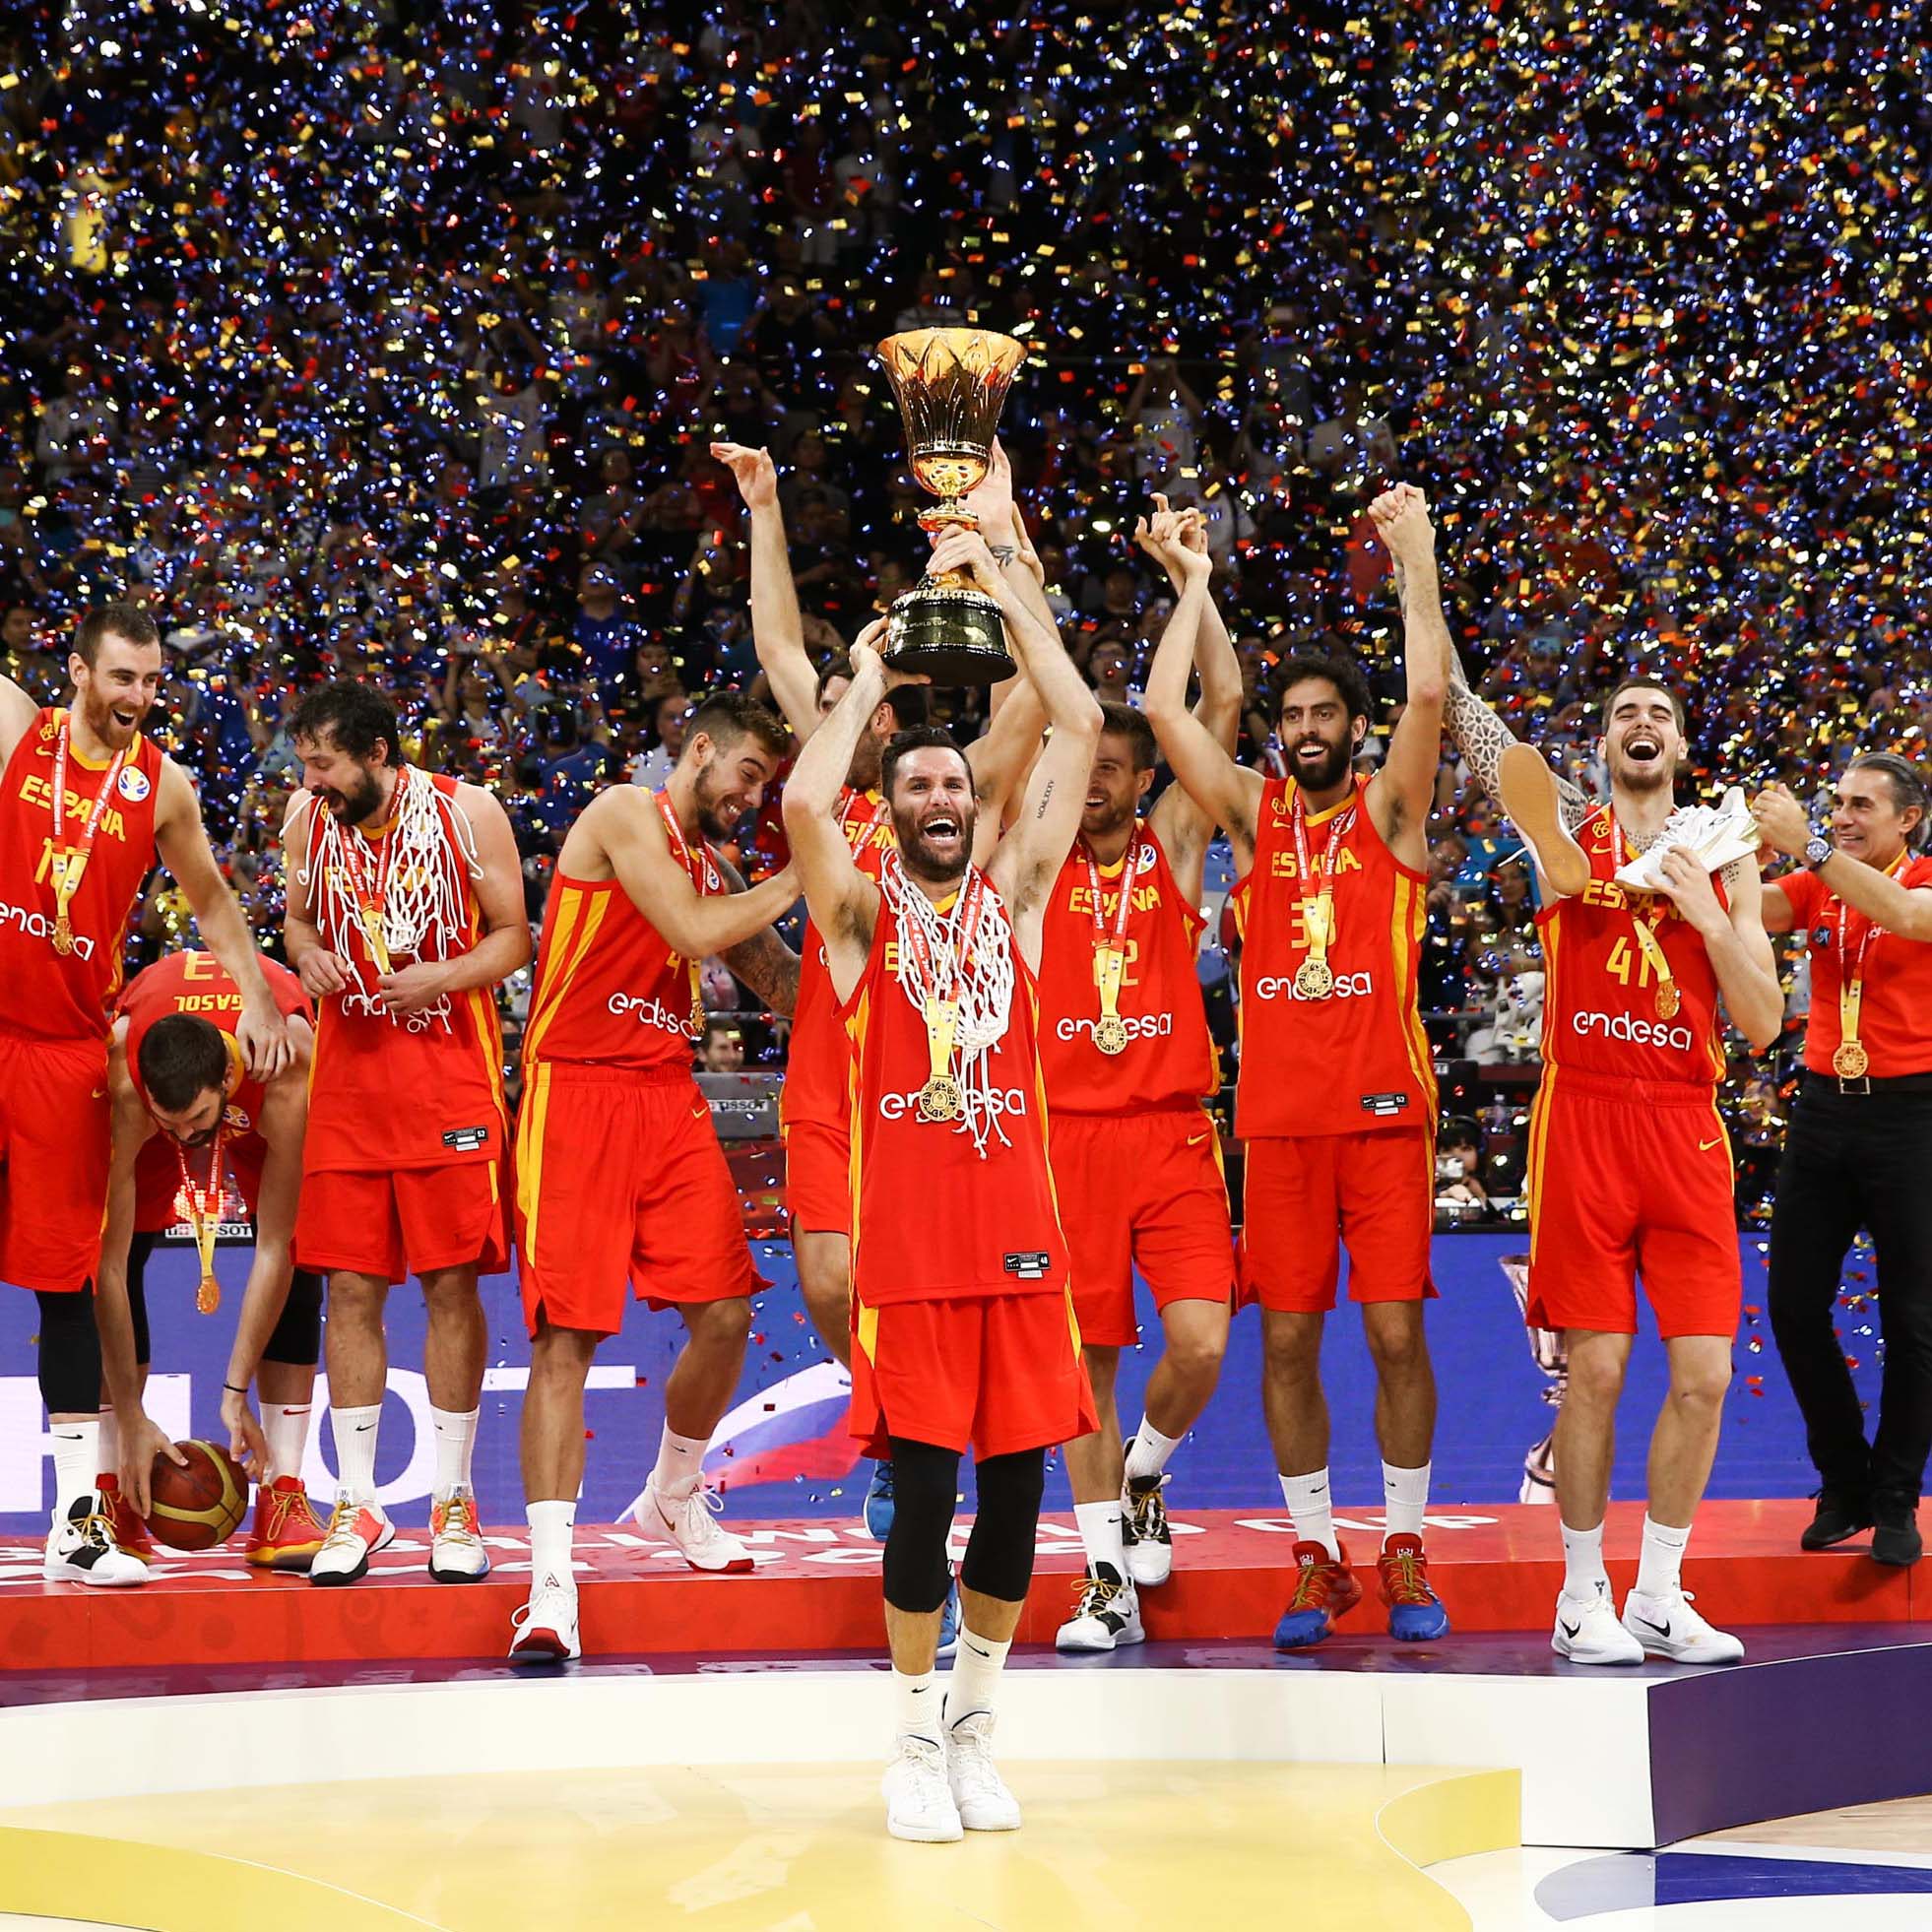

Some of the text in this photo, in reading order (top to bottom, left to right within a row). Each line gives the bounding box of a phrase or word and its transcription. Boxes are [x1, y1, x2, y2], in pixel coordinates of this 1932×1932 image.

[1291, 902, 1336, 949] 3
[1091, 938, 1139, 987] 2
[1606, 936, 1650, 989] 41
[173, 994, 244, 1012] GASOL
[1256, 972, 1372, 1001] ensa
[1057, 1012, 1172, 1042] enesa
[1573, 1010, 1693, 1052] endesa
[880, 1088, 1026, 1121] enesa
